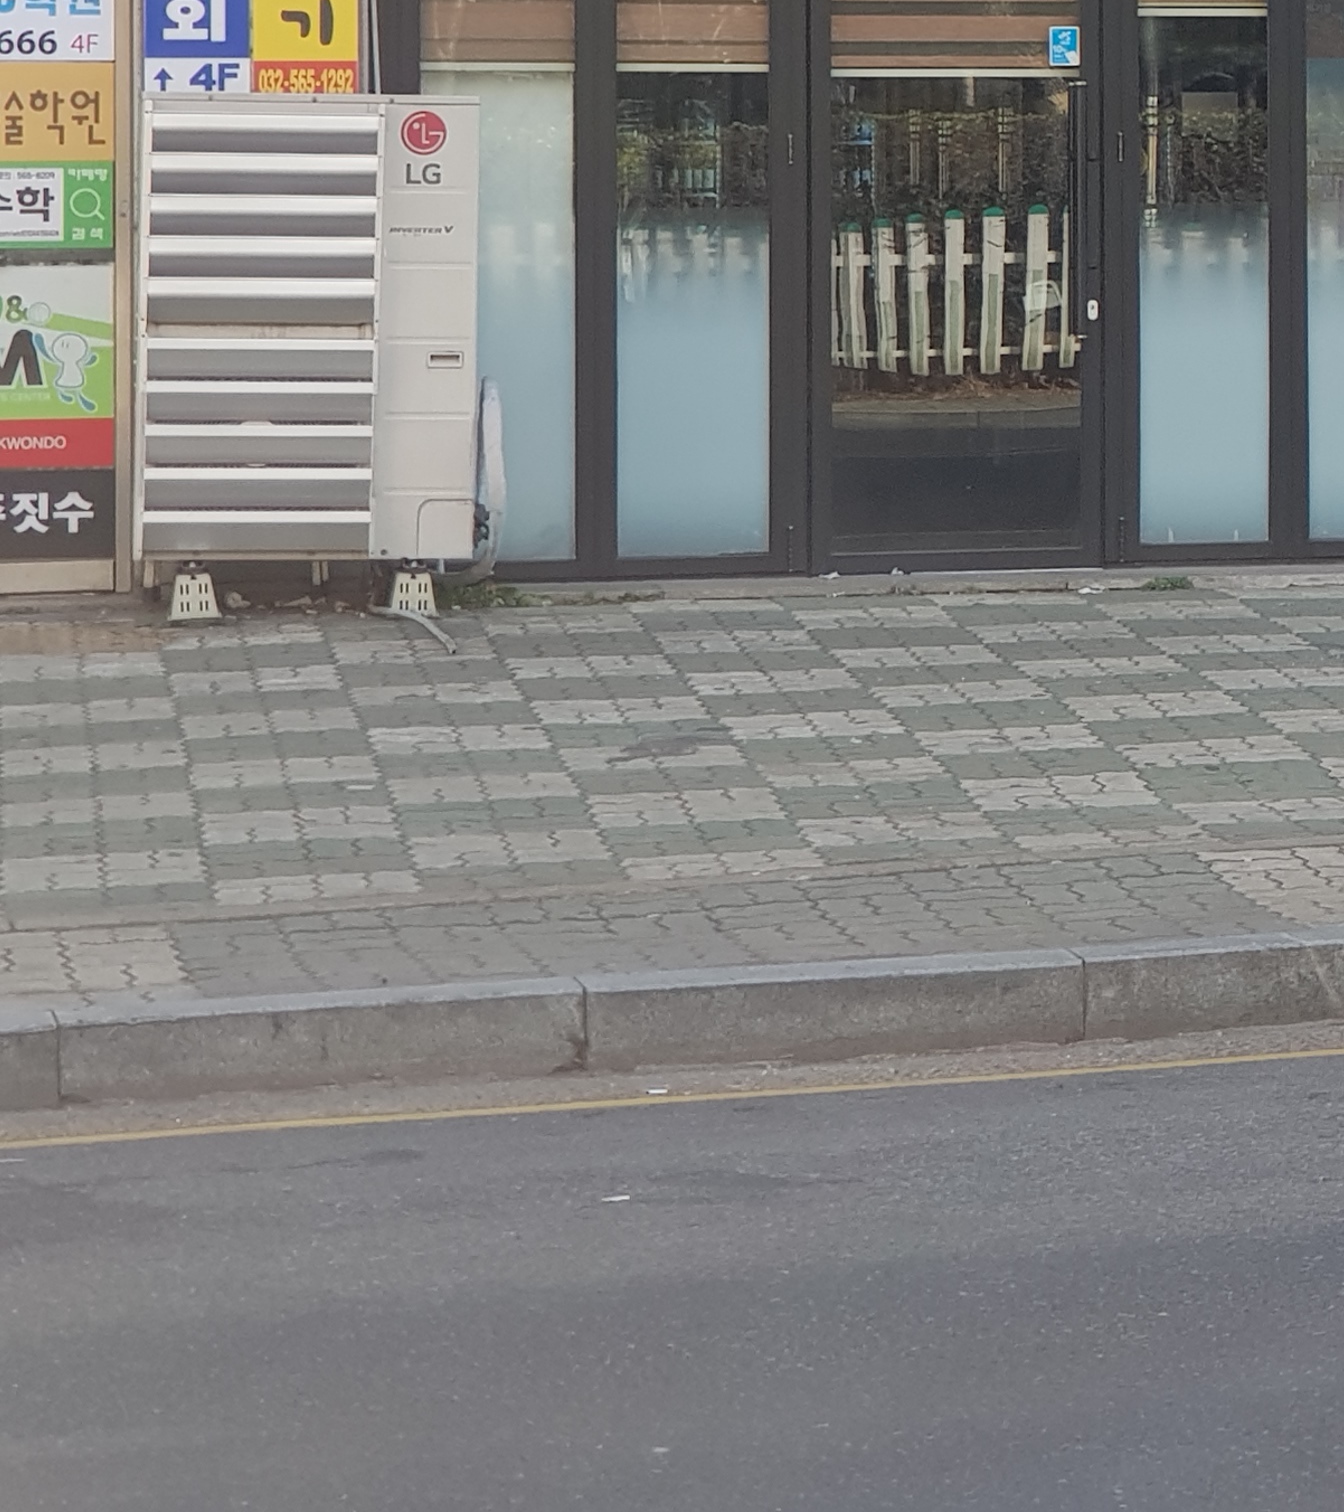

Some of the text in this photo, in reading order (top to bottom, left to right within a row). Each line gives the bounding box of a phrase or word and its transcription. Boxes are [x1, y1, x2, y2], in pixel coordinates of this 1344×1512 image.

[70, 33, 99, 54] 4F
[189, 63, 240, 91] 4F
[258, 67, 355, 94] 032-565-1292
[406, 163, 441, 185] LG
